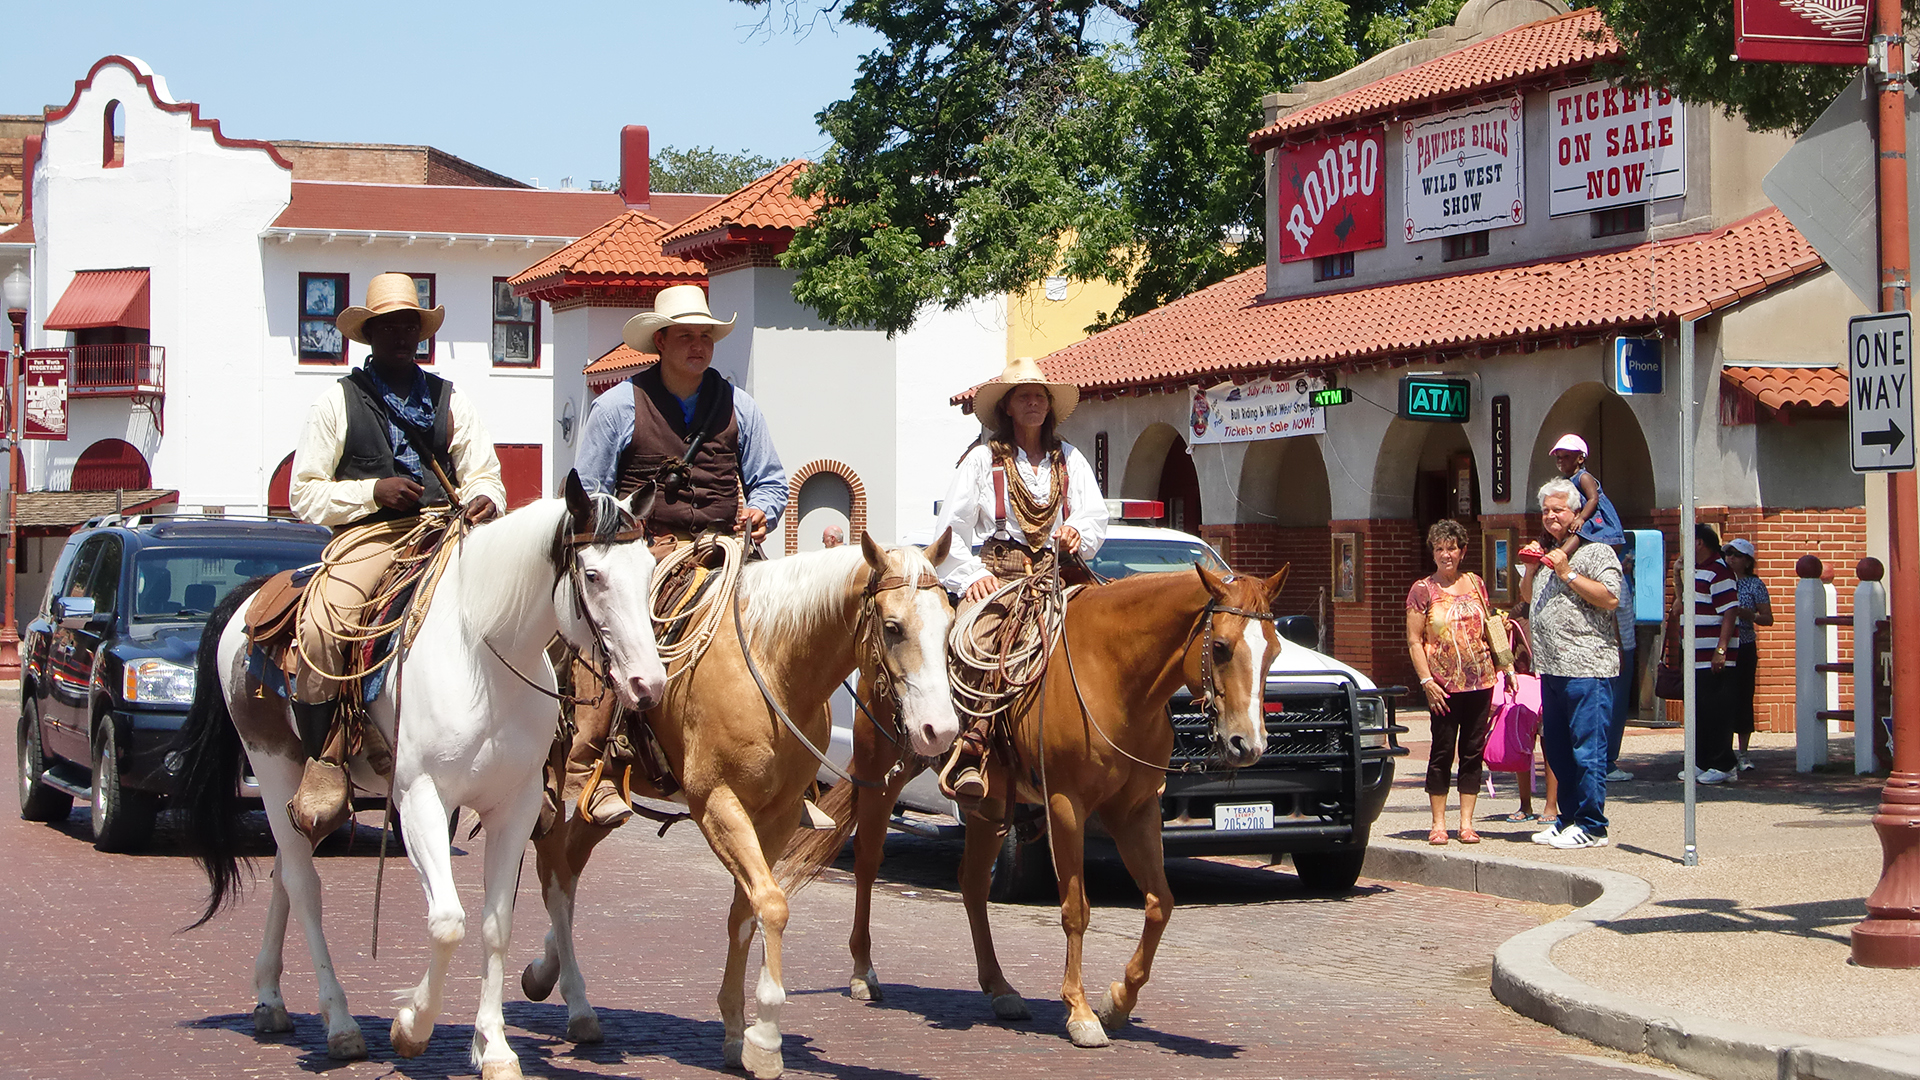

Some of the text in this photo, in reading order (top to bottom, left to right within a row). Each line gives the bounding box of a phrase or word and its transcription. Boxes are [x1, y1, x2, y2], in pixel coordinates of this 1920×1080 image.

[1557, 81, 1672, 126] TICKETS
[1417, 119, 1508, 175] PAWNEE BILLS
[1558, 116, 1673, 166] ON SALE
[1286, 139, 1377, 255] RODEO
[1422, 163, 1503, 196] WILD WEST
[1587, 162, 1645, 200] NOW
[1443, 192, 1482, 217] SHOW
[1629, 360, 1659, 371] Phone
[1856, 330, 1905, 369] ONE
[1247, 385, 1260, 398] July
[1276, 382, 1290, 393] 2011
[1315, 389, 1342, 405] ATM
[1413, 388, 1463, 412] ATM
[1856, 373, 1906, 411] WAY
[1224, 417, 1315, 437] Tickets on Sale NOW!
[1241, 407, 1258, 422] Riding
[1265, 404, 1277, 417] Wild
[1293, 402, 1309, 413] Show
[1496, 403, 1504, 494] TICKETS
